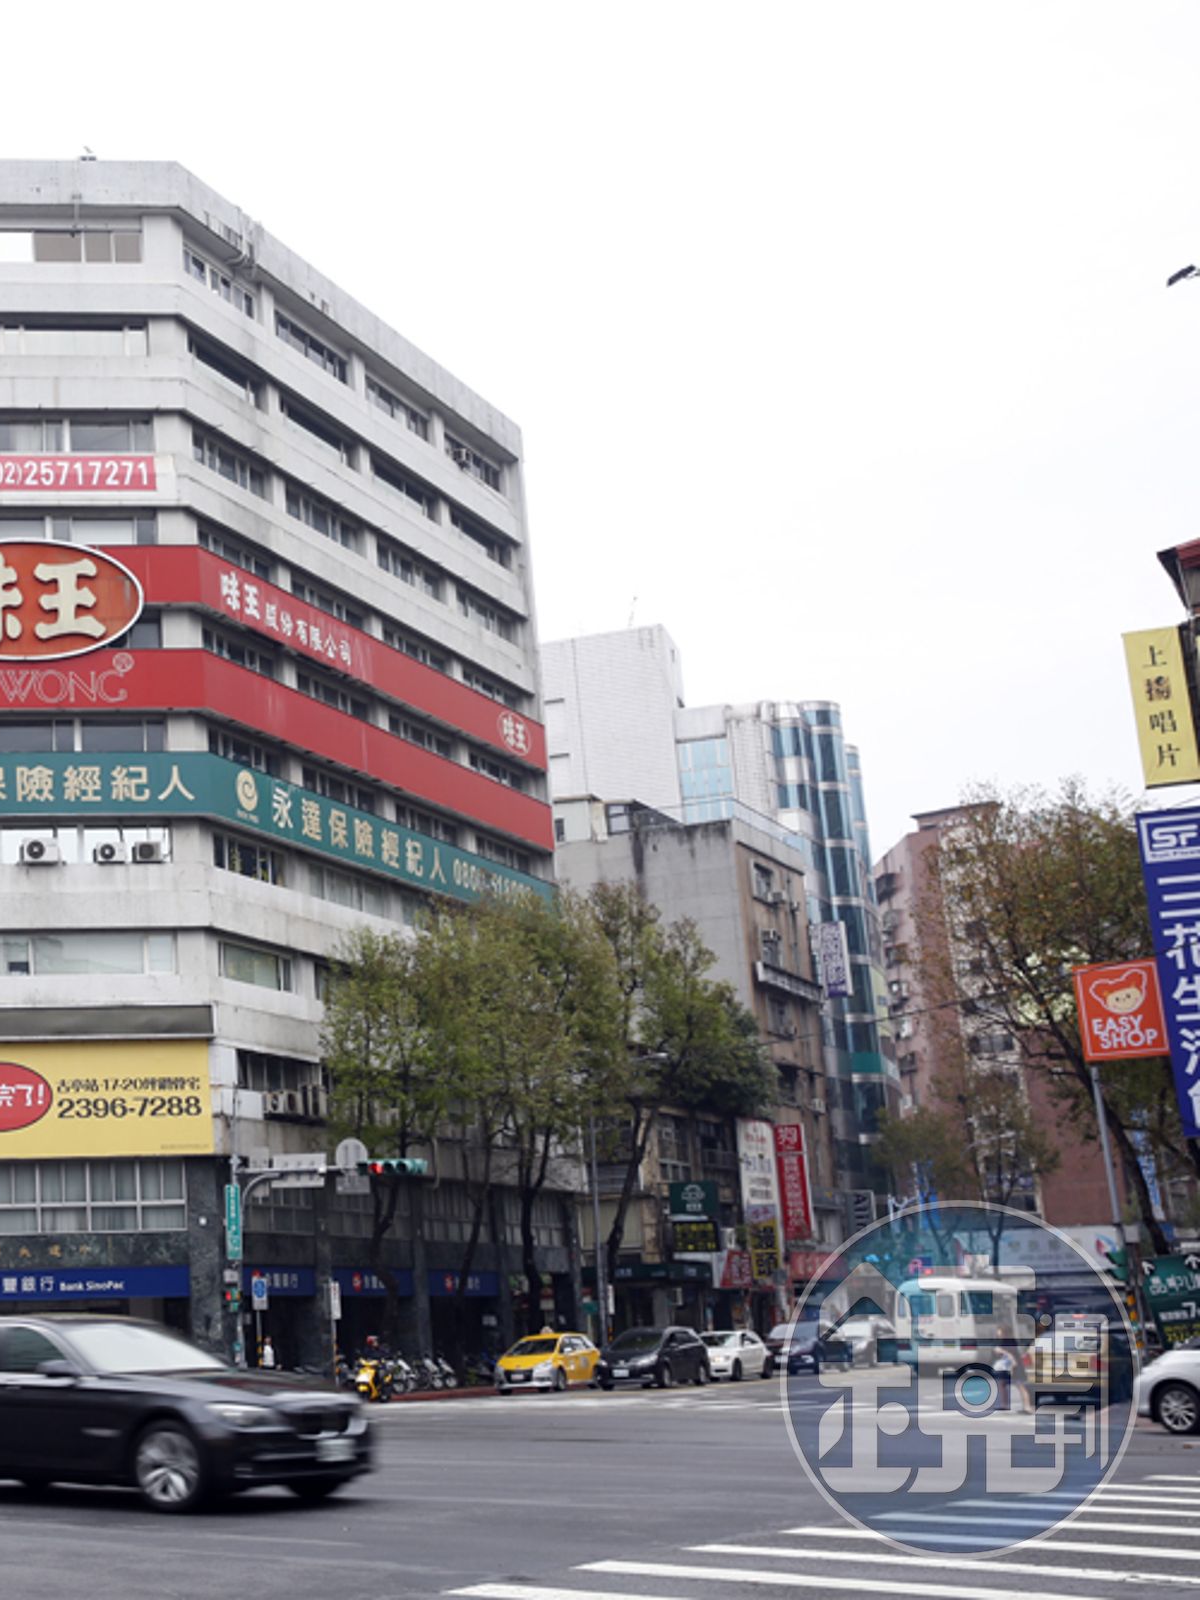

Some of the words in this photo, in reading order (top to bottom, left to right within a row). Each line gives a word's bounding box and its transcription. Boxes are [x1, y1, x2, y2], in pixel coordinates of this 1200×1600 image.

[272, 785, 448, 886] 永達保險經紀人
[1092, 1014, 1144, 1037] EASY
[1100, 1028, 1158, 1050] SHOP
[57, 1096, 202, 1119] 2396-7288
[59, 1281, 84, 1292] Bank
